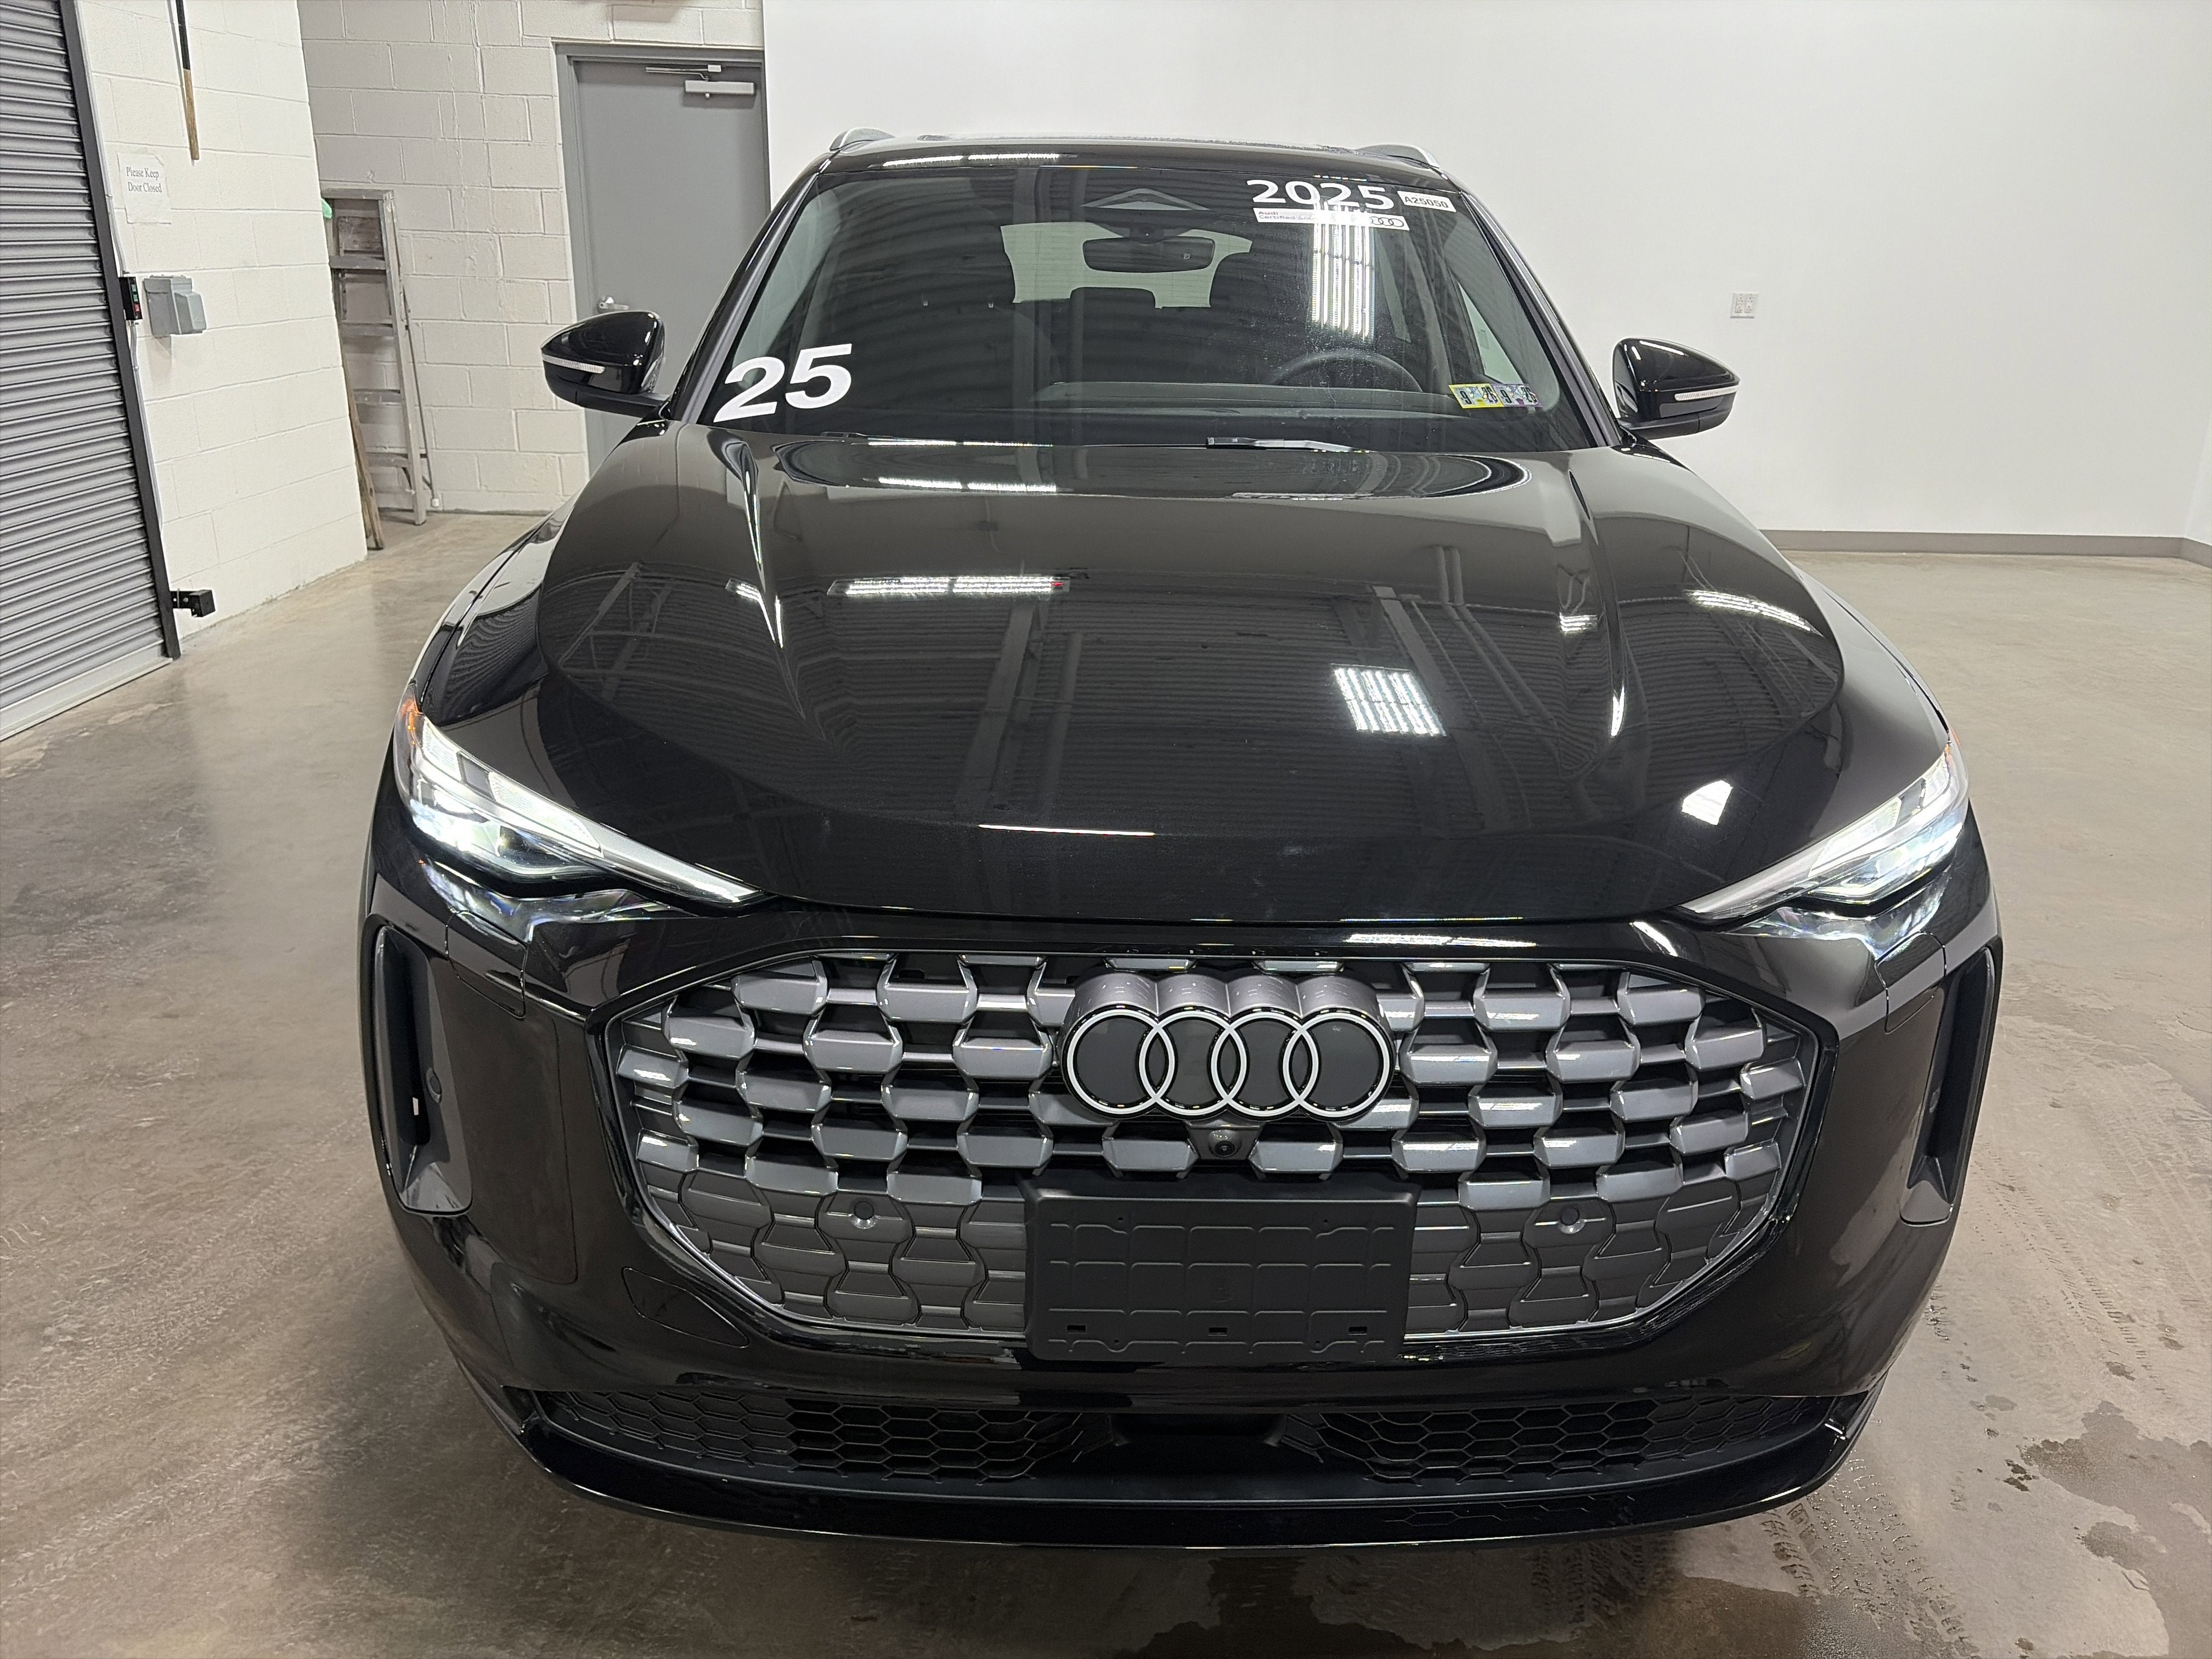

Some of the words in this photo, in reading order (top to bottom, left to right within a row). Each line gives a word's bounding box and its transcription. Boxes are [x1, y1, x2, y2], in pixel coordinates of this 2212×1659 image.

[126, 167, 144, 177] Please
[144, 168, 159, 180] Keep
[128, 182, 142, 191] Door
[143, 182, 162, 193] Closed
[1246, 179, 1395, 210] 2025
[1404, 196, 1449, 208] A25050
[713, 343, 852, 423] 25
[1460, 391, 1472, 404] 9
[1500, 390, 1513, 403] 9
